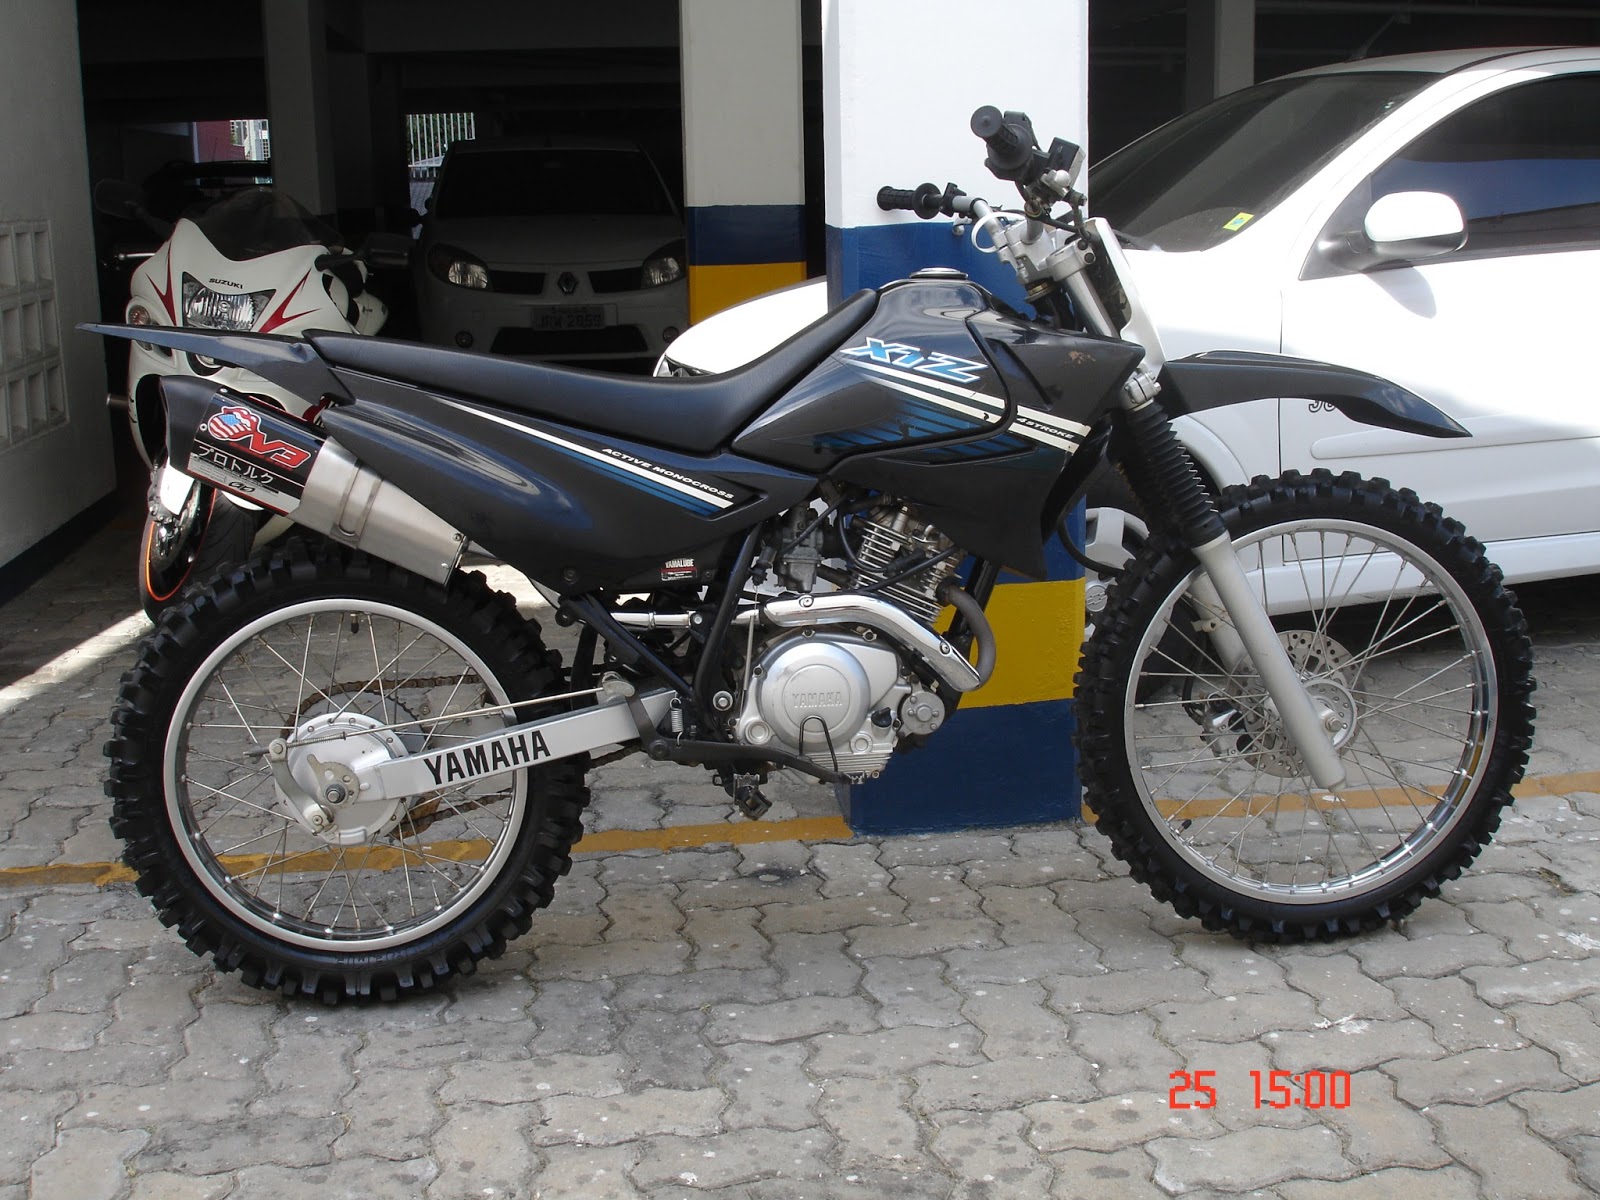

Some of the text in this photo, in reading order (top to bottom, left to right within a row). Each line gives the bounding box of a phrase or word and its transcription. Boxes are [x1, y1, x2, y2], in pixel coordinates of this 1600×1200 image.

[209, 278, 243, 289] SUZUKI
[1016, 417, 1075, 439] 4STROKE
[602, 448, 734, 499] ACTIVE MONOCROSS
[665, 558, 695, 569] YAMALUBE
[792, 691, 843, 708] YAMAHA
[423, 730, 551, 785] YAMAHA
